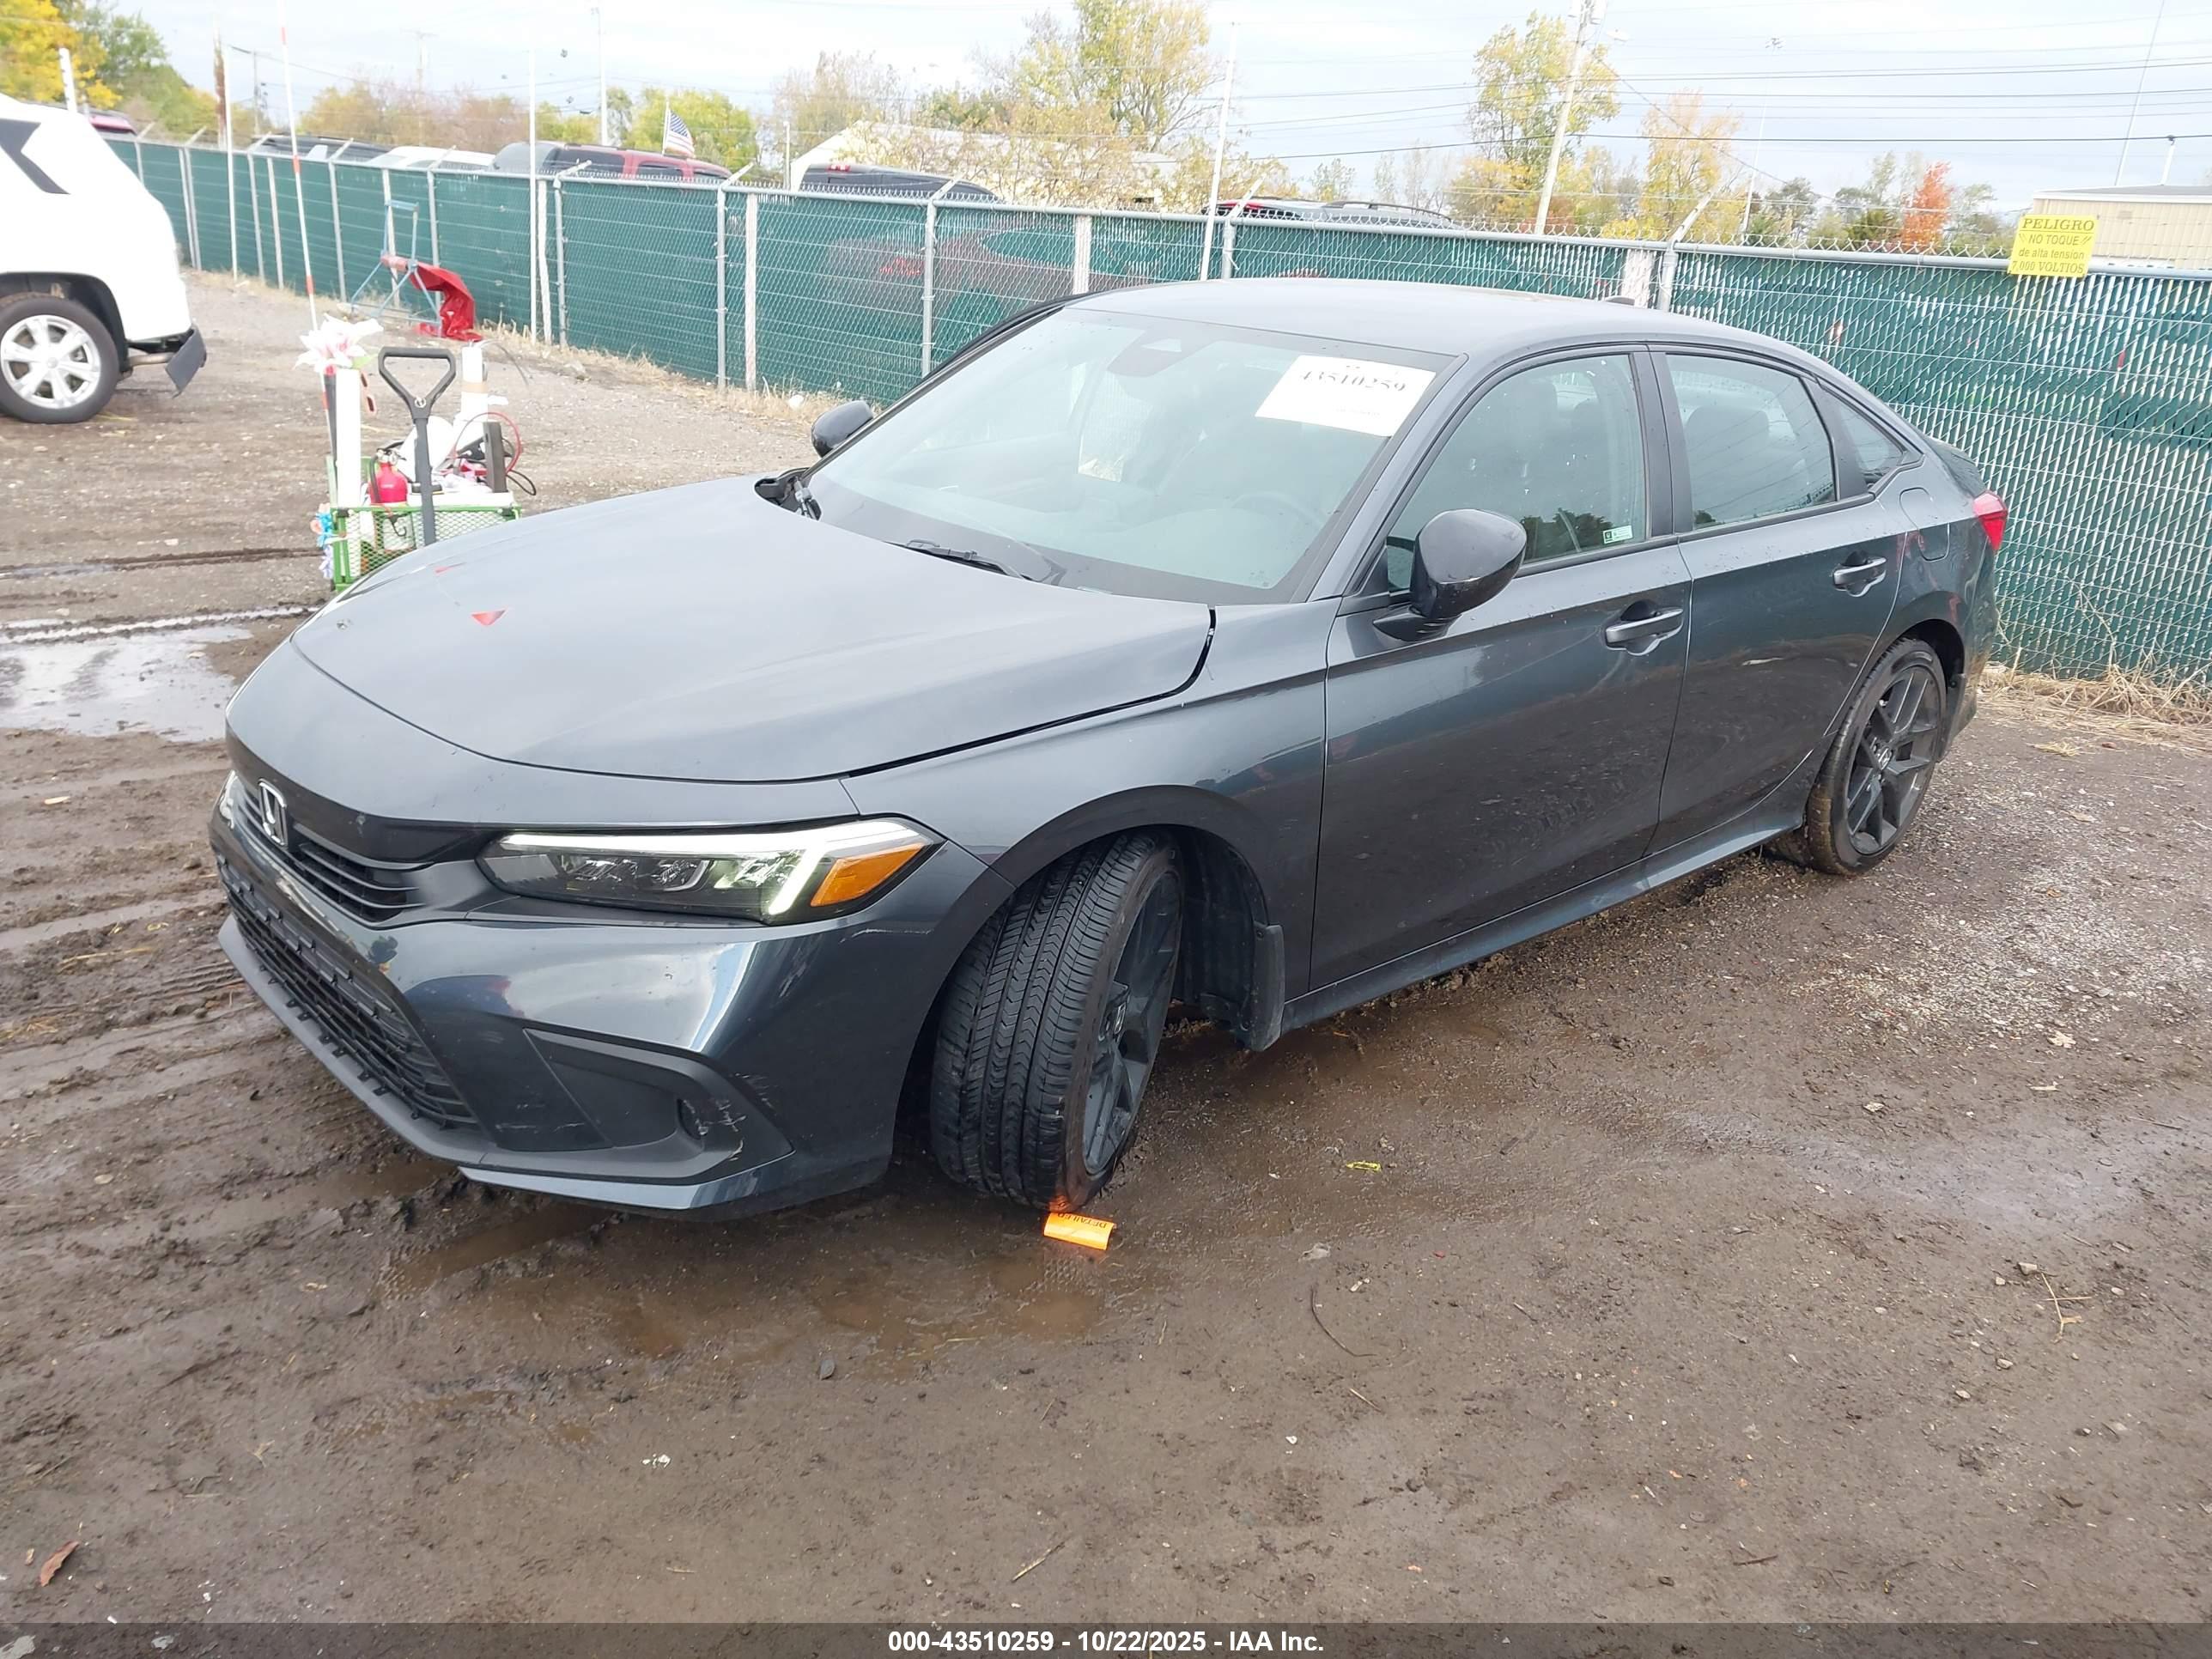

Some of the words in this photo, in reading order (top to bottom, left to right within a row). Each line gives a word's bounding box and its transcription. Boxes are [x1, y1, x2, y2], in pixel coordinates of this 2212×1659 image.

[2021, 218, 2094, 231] PELIGRO
[2028, 234, 2044, 244] NO
[2046, 234, 2080, 246] TOQUE
[2019, 247, 2030, 258] de
[2032, 248, 2049, 258] alta
[2039, 261, 2085, 274] VOLTIOS
